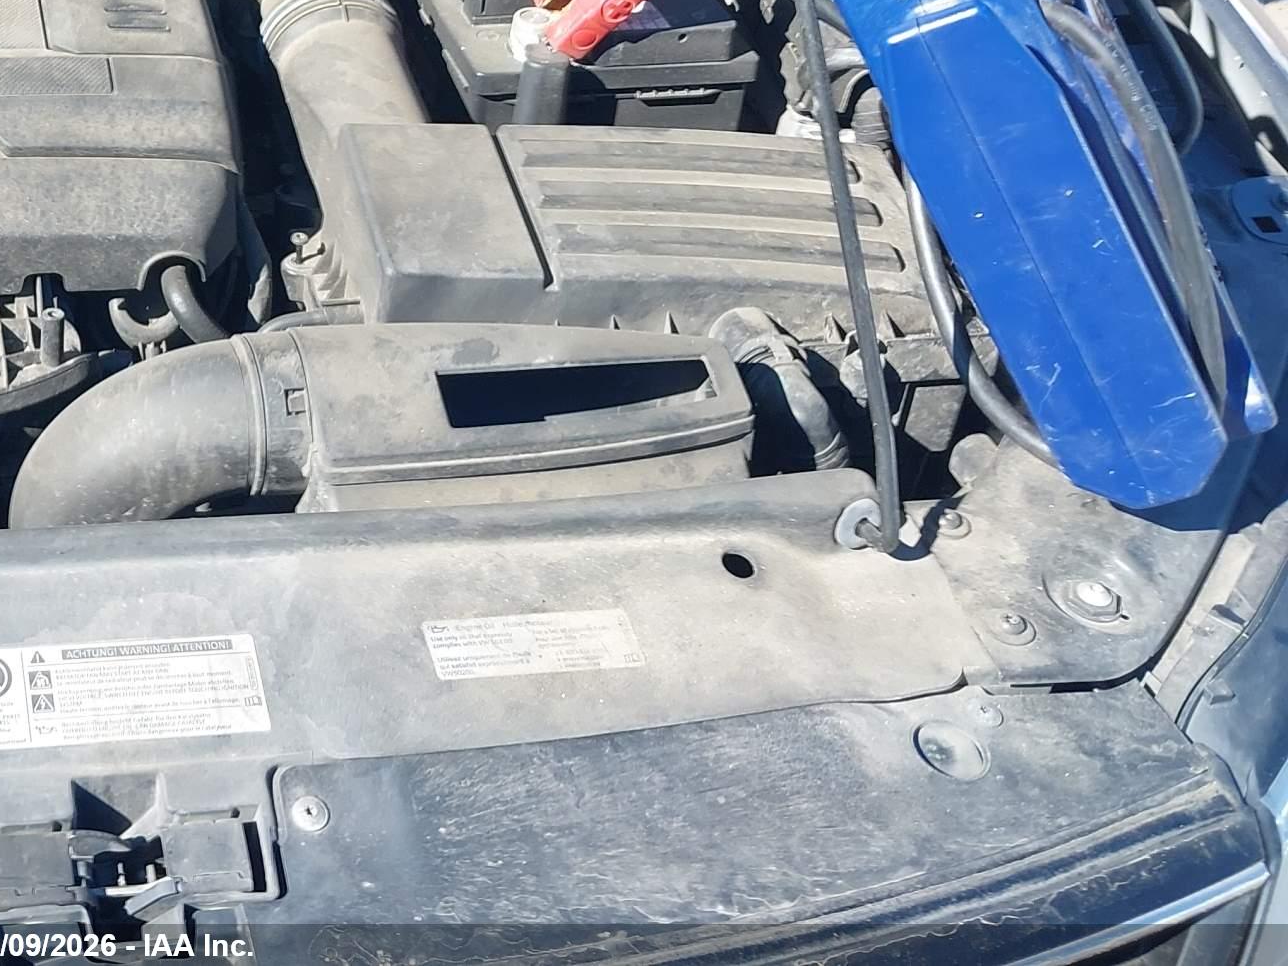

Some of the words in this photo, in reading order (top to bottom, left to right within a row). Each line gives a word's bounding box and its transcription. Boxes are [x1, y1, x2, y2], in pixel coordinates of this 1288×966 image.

[66, 647, 117, 658] ACHTUNG!
[119, 644, 170, 655] WARNING!
[172, 640, 229, 651] ATTENTION!
